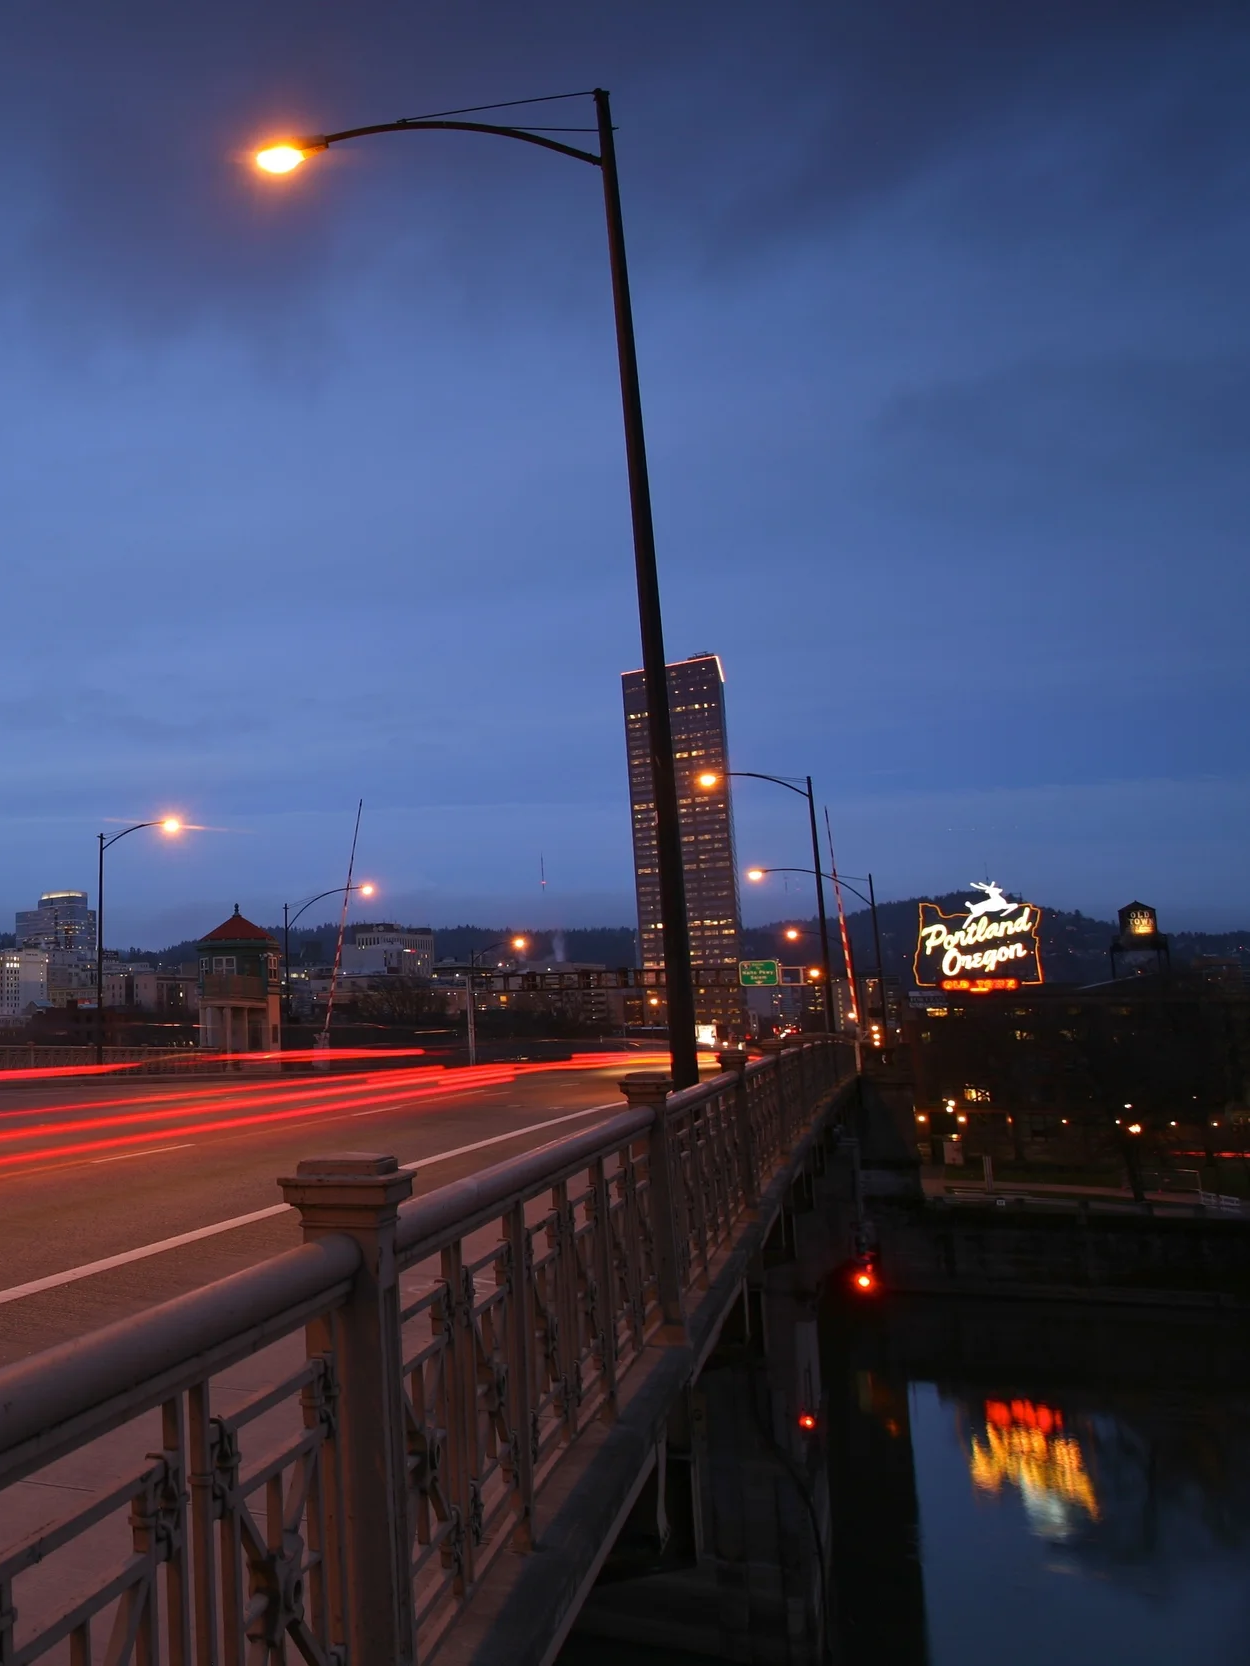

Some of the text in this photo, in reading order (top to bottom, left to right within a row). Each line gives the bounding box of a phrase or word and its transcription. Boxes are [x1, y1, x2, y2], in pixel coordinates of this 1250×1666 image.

[921, 907, 1032, 956] Portland
[942, 943, 1027, 976] Oregon
[943, 979, 1017, 989] OLD TOWN
